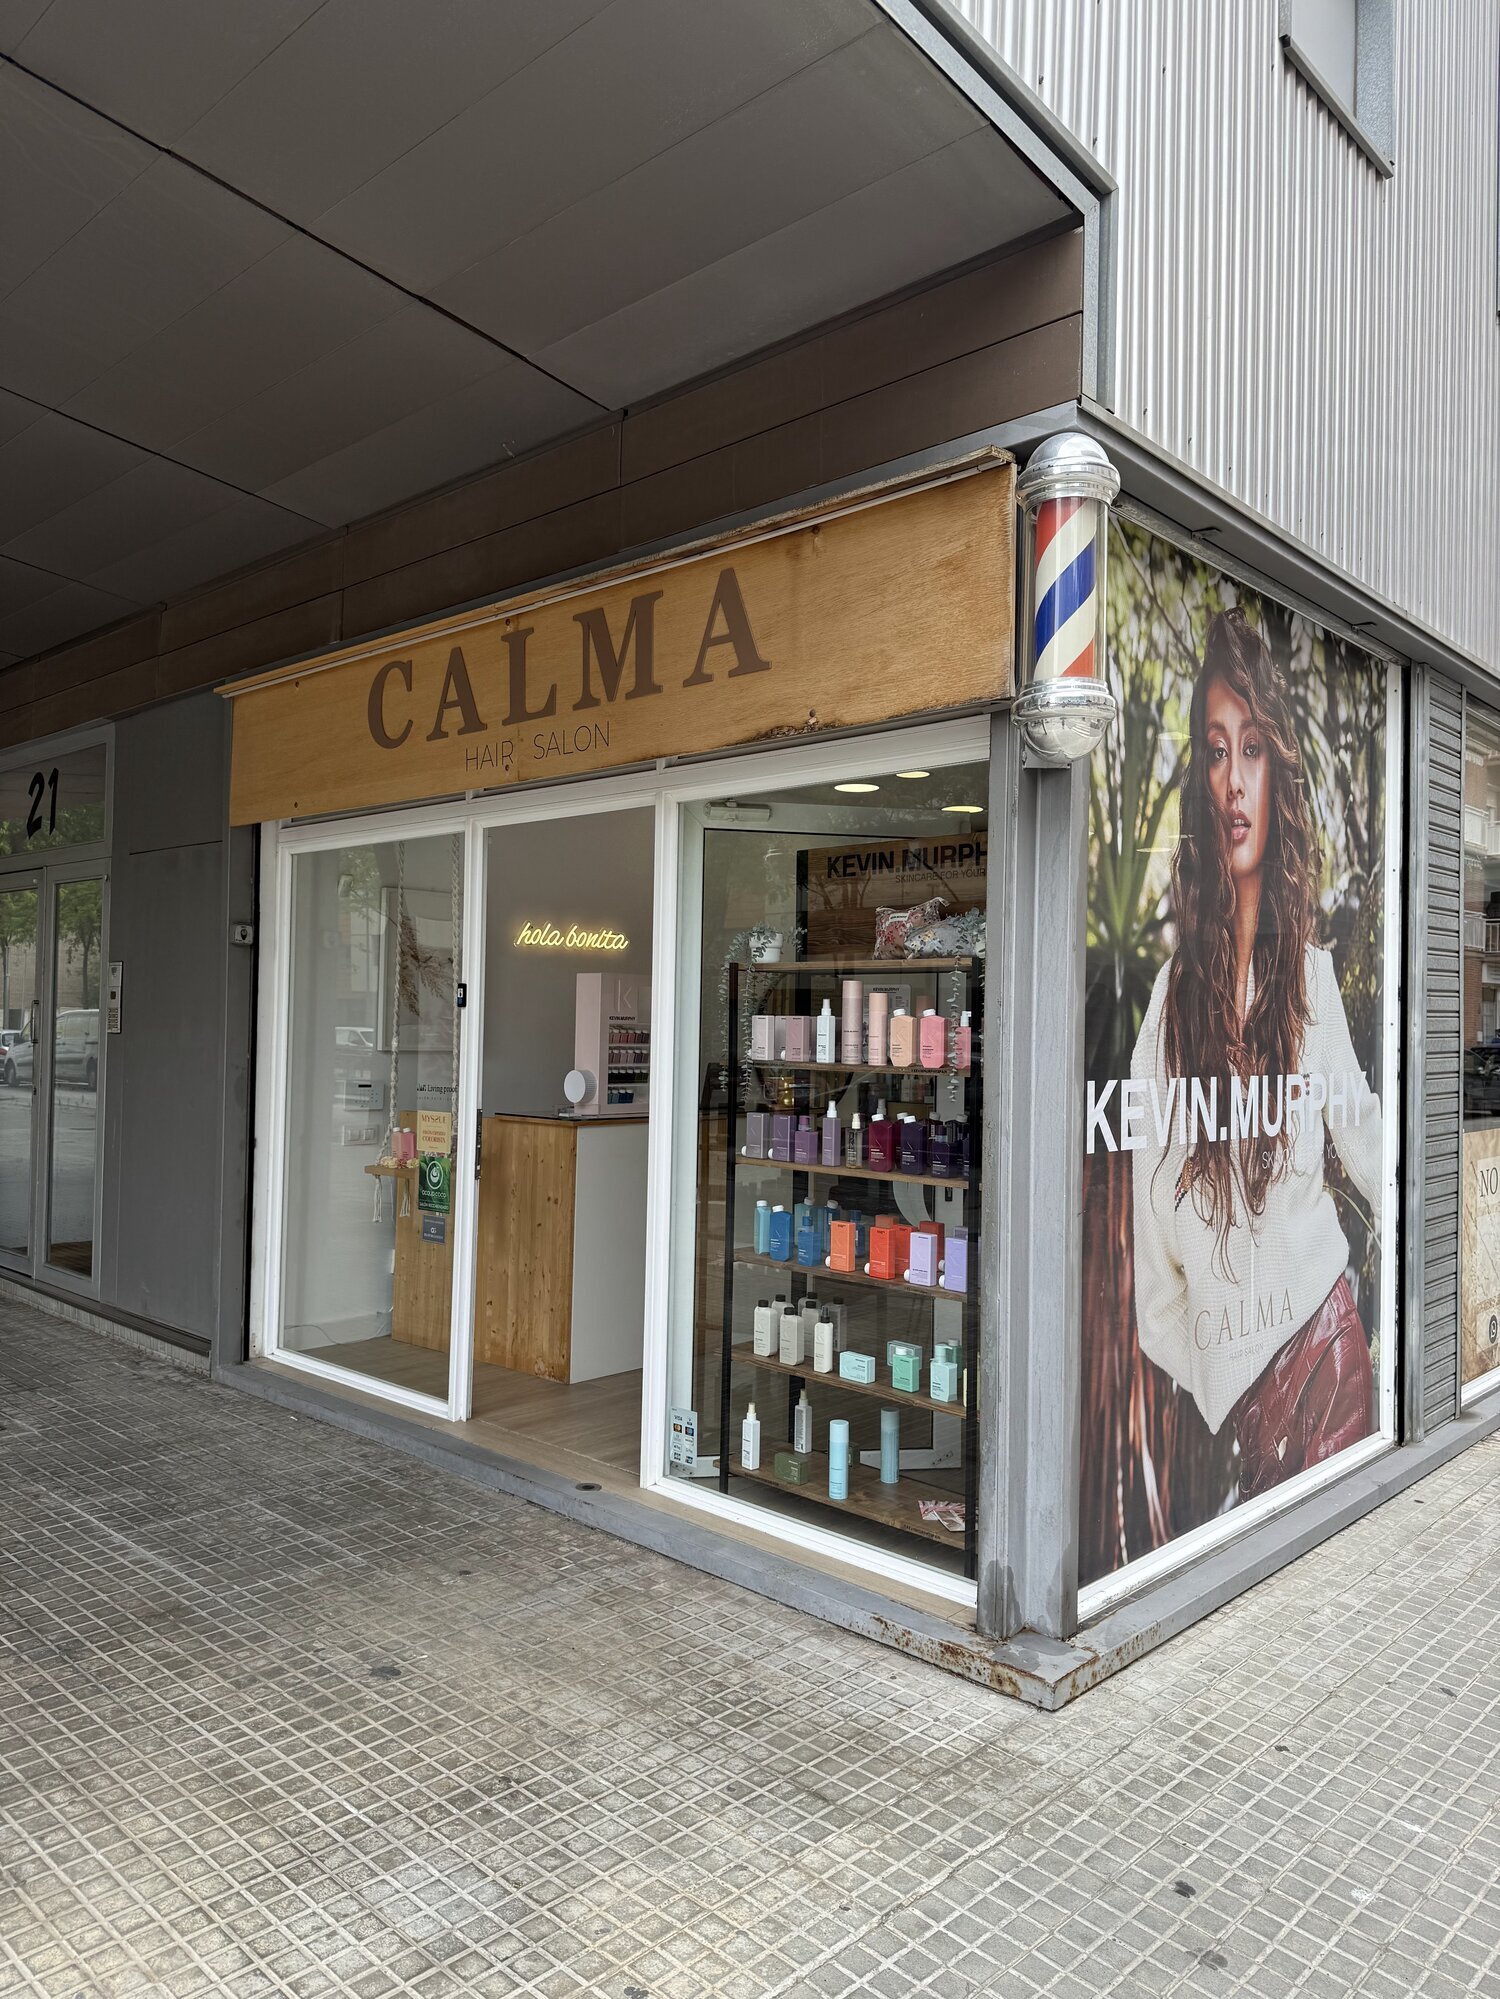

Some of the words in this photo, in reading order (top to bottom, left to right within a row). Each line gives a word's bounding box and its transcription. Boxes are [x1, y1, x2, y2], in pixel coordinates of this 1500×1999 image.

[367, 567, 772, 749] CALMA
[465, 740, 513, 772] HAIR
[533, 720, 610, 760] SALON
[27, 767, 59, 840] 21
[827, 841, 988, 879] KEVIN.MURPH
[895, 871, 939, 884] SKINCARE
[941, 870, 959, 880] FOR
[515, 921, 565, 947] hola
[565, 924, 629, 950] bonita
[1086, 1071, 1367, 1155] KEVIN.MURPHY
[1194, 1287, 1294, 1351] CALMA
